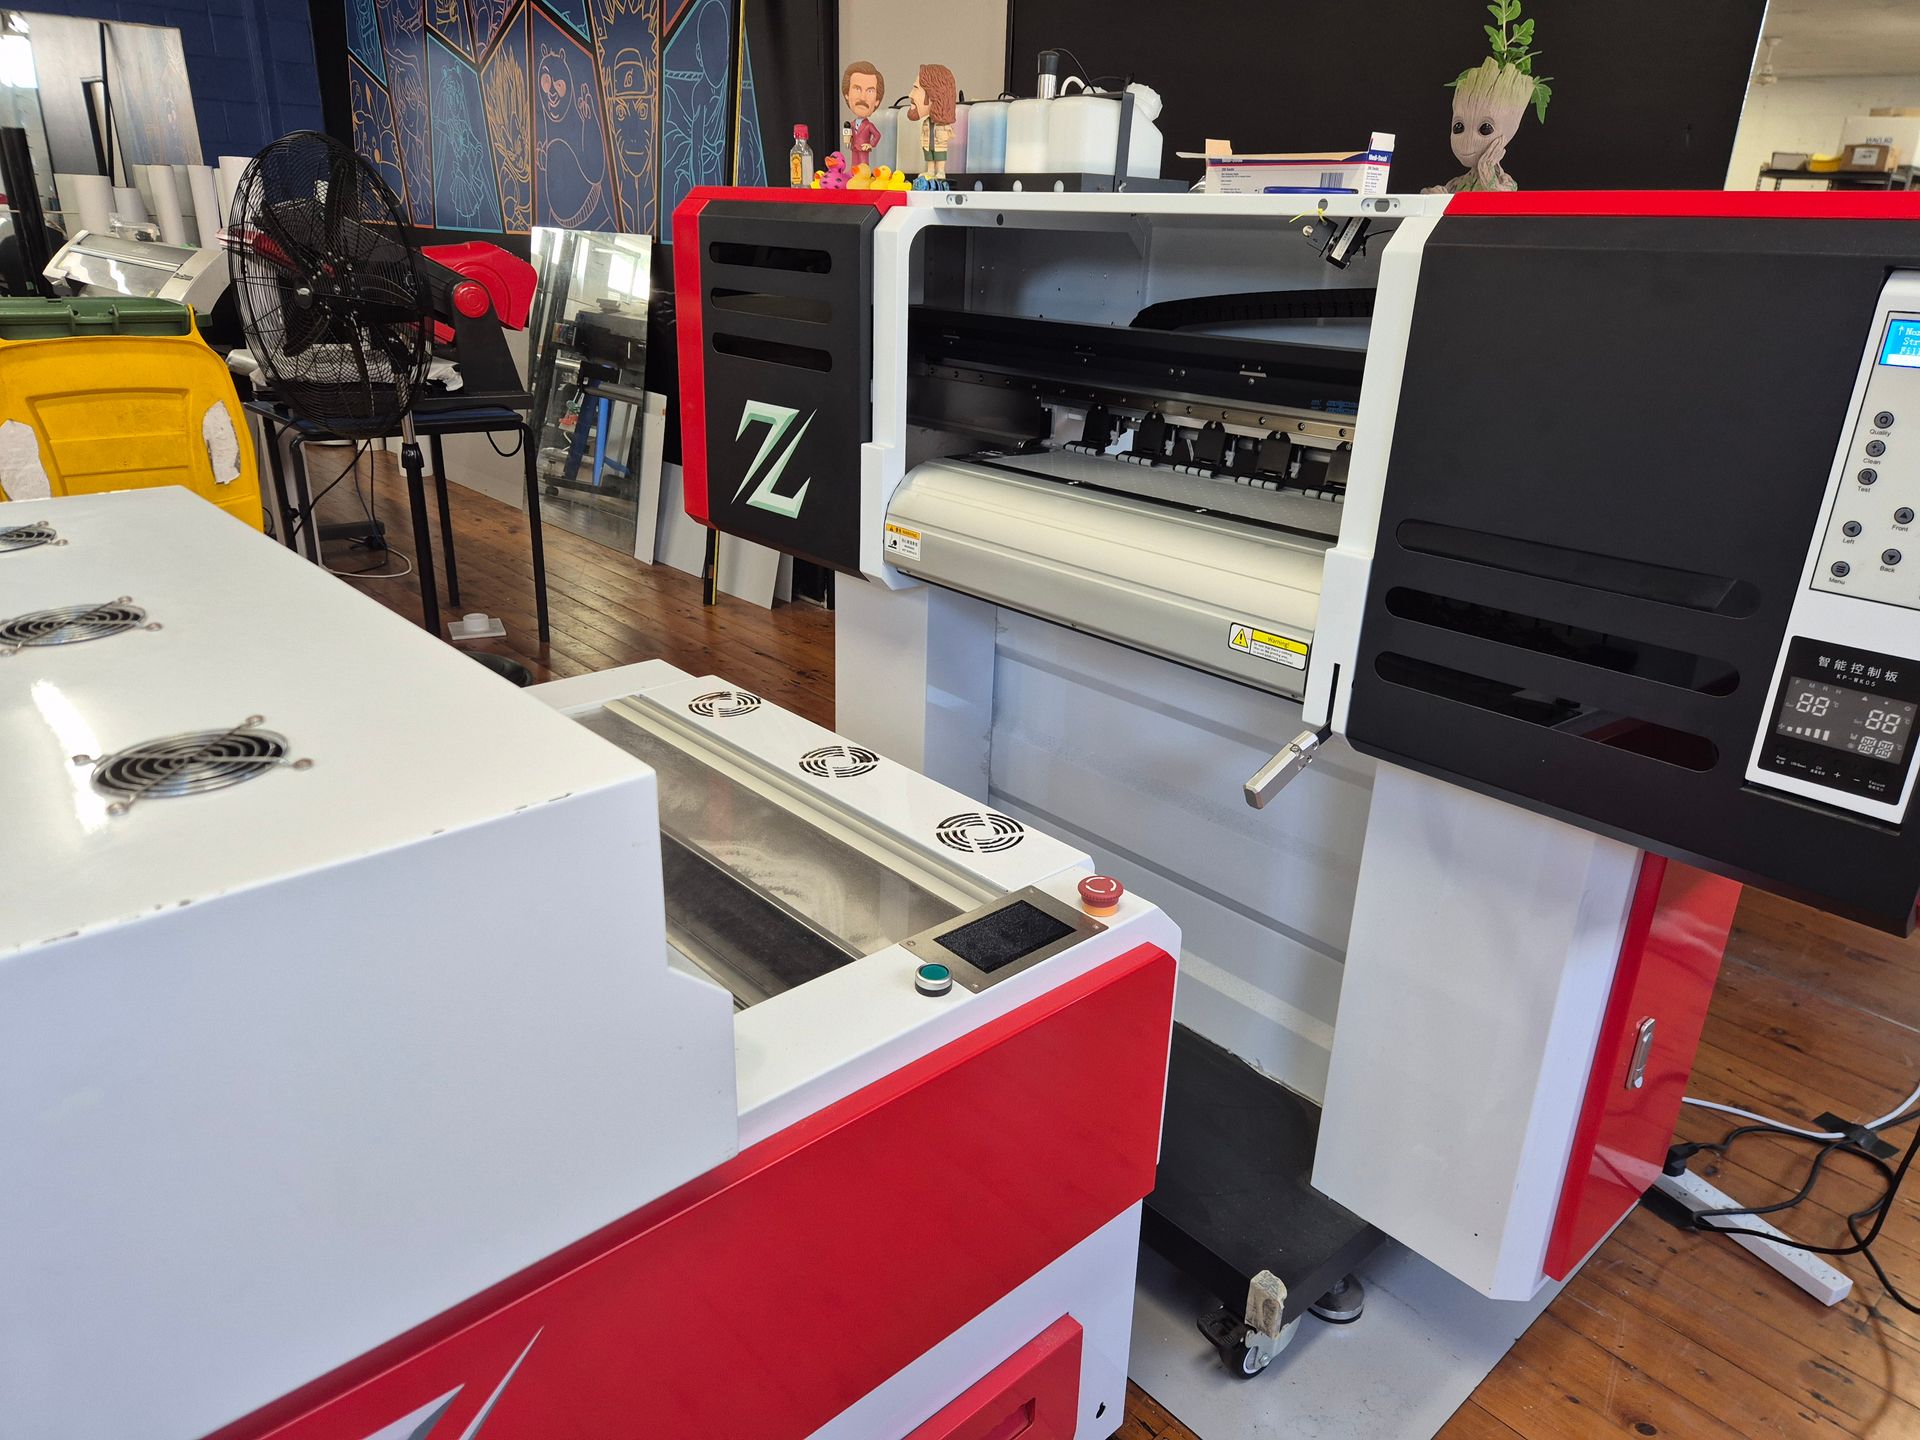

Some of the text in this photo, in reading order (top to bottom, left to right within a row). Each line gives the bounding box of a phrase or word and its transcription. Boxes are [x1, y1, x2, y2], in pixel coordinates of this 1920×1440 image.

[1869, 428, 1891, 437] Quality
[1862, 457, 1881, 465] Clean
[1857, 485, 1871, 494] Test
[1891, 524, 1909, 532] Front
[1879, 565, 1895, 573] Back
[1828, 577, 1846, 585] Menu
[1267, 636, 1290, 649] Warning!
[1818, 655, 1899, 683] 智能控制板
